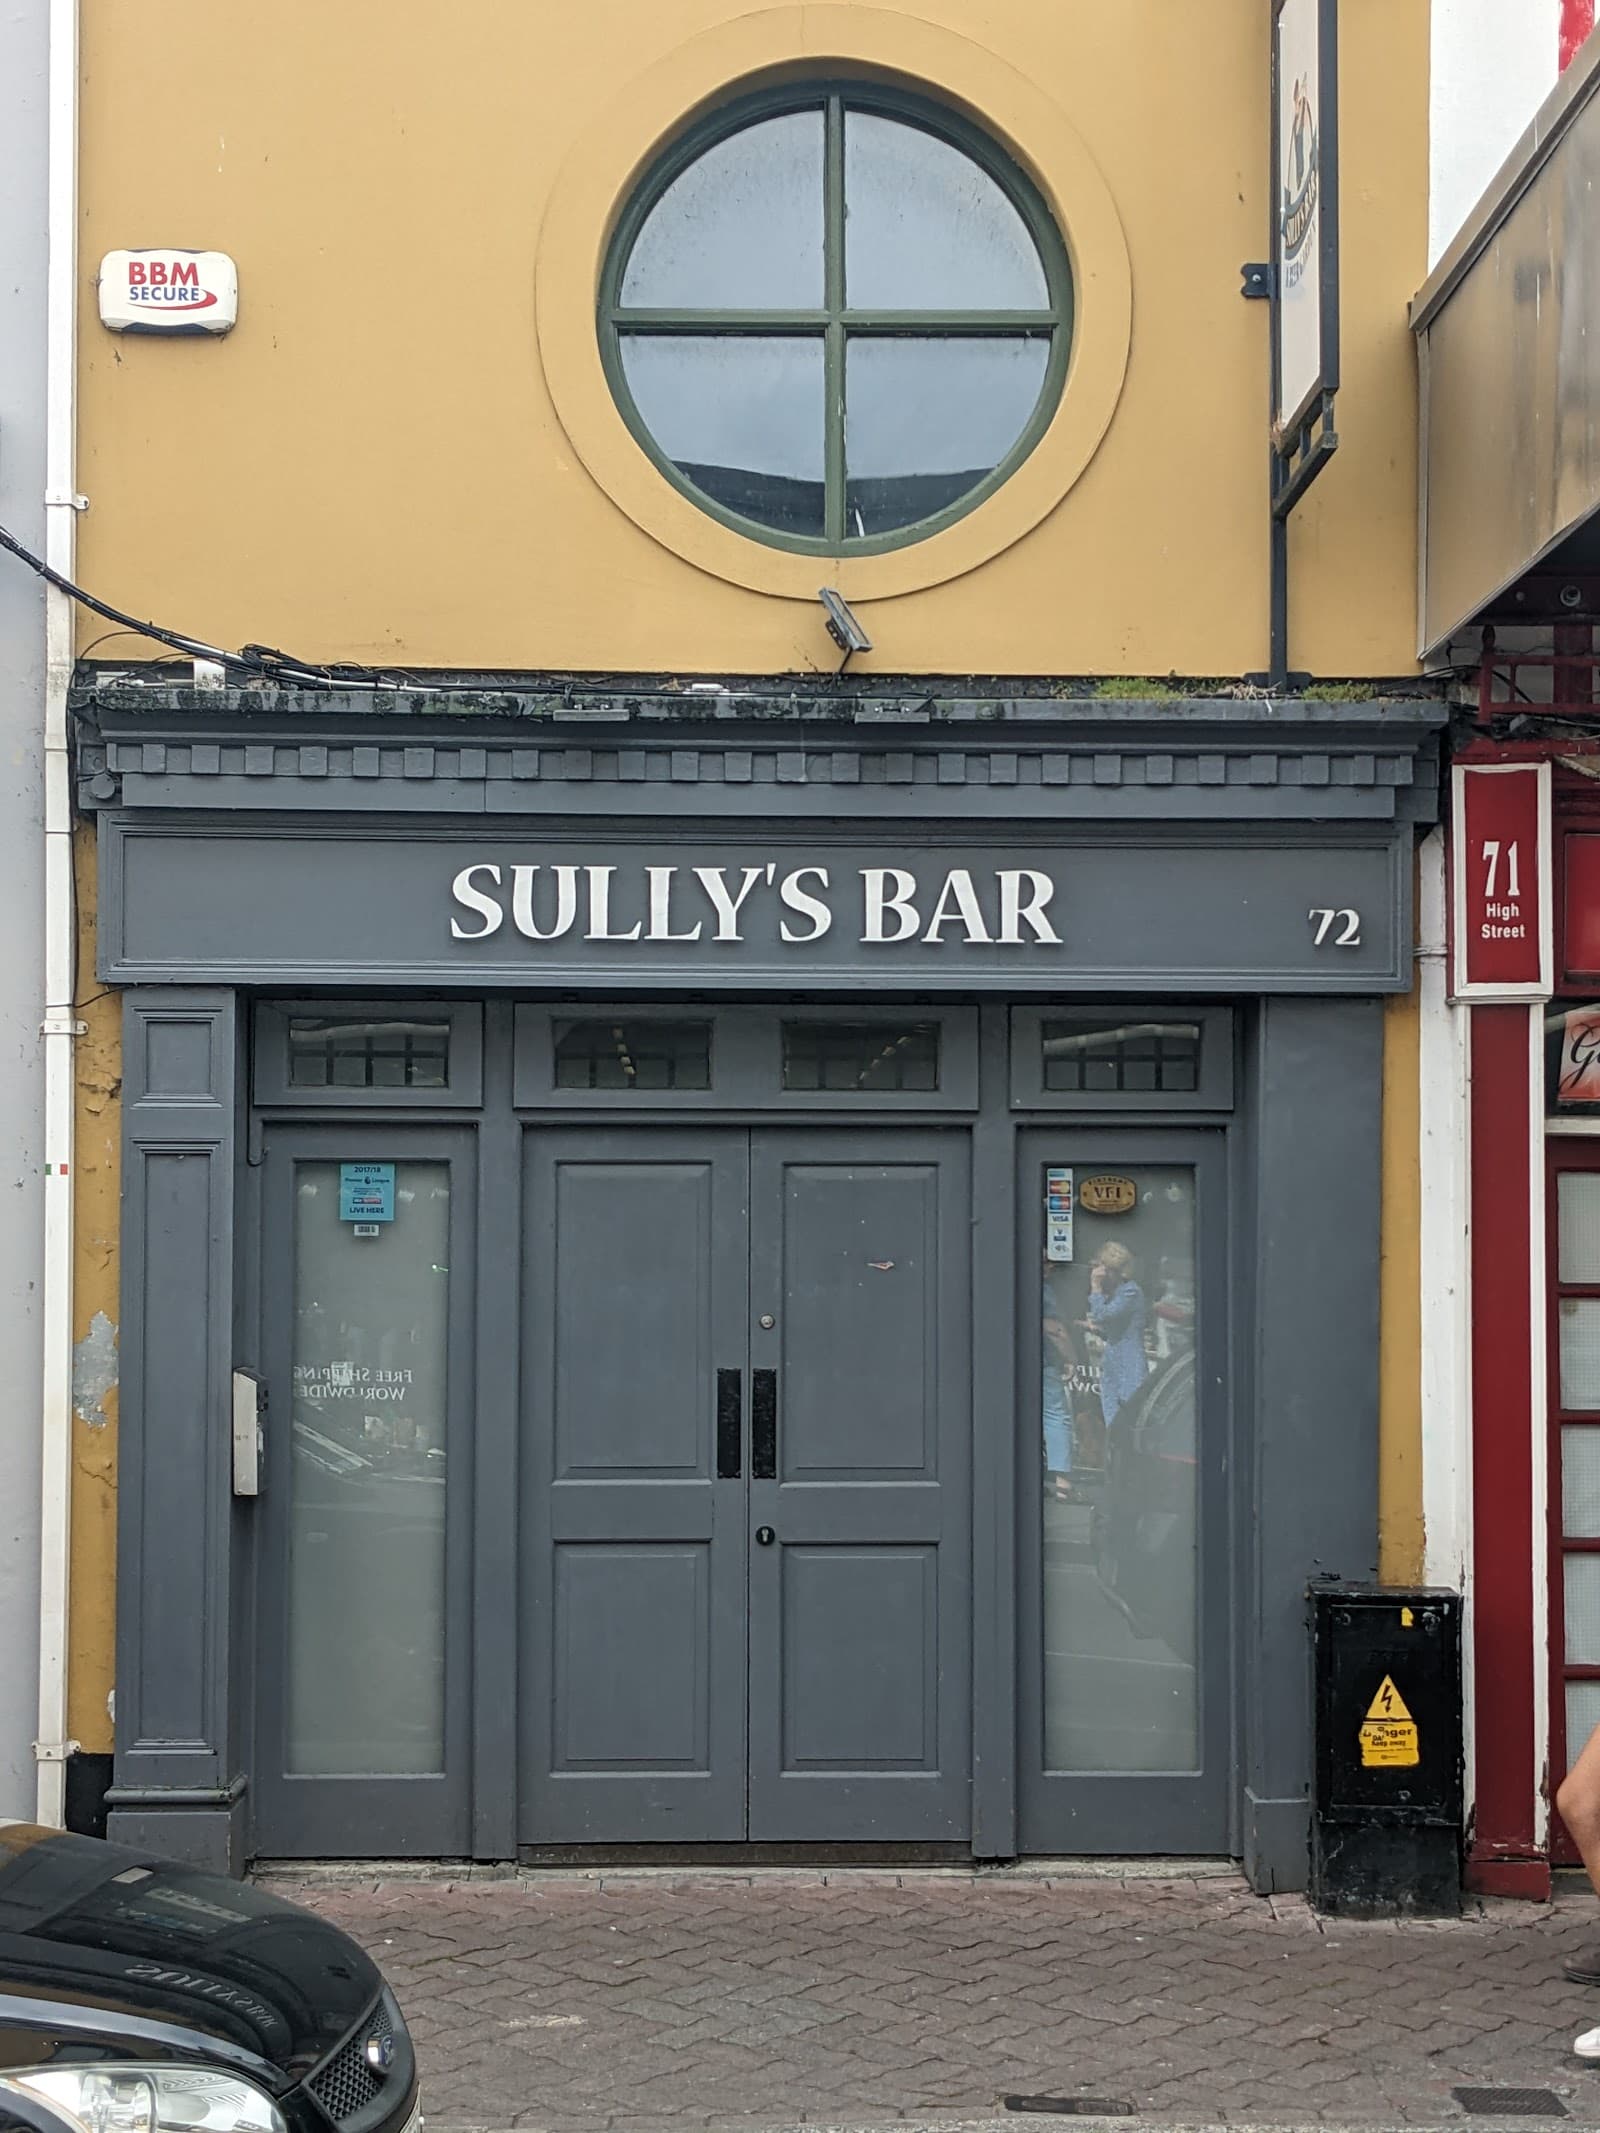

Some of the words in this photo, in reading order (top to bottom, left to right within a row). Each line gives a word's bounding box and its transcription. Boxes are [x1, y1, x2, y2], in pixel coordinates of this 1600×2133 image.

[129, 262, 199, 286] BBM
[129, 286, 200, 302] SECURE
[1482, 840, 1521, 897] 71
[449, 862, 832, 943] SULLY'S
[857, 868, 1064, 944] BAR
[1486, 902, 1520, 921] High
[1308, 909, 1361, 945] 72
[1481, 923, 1526, 939] Street
